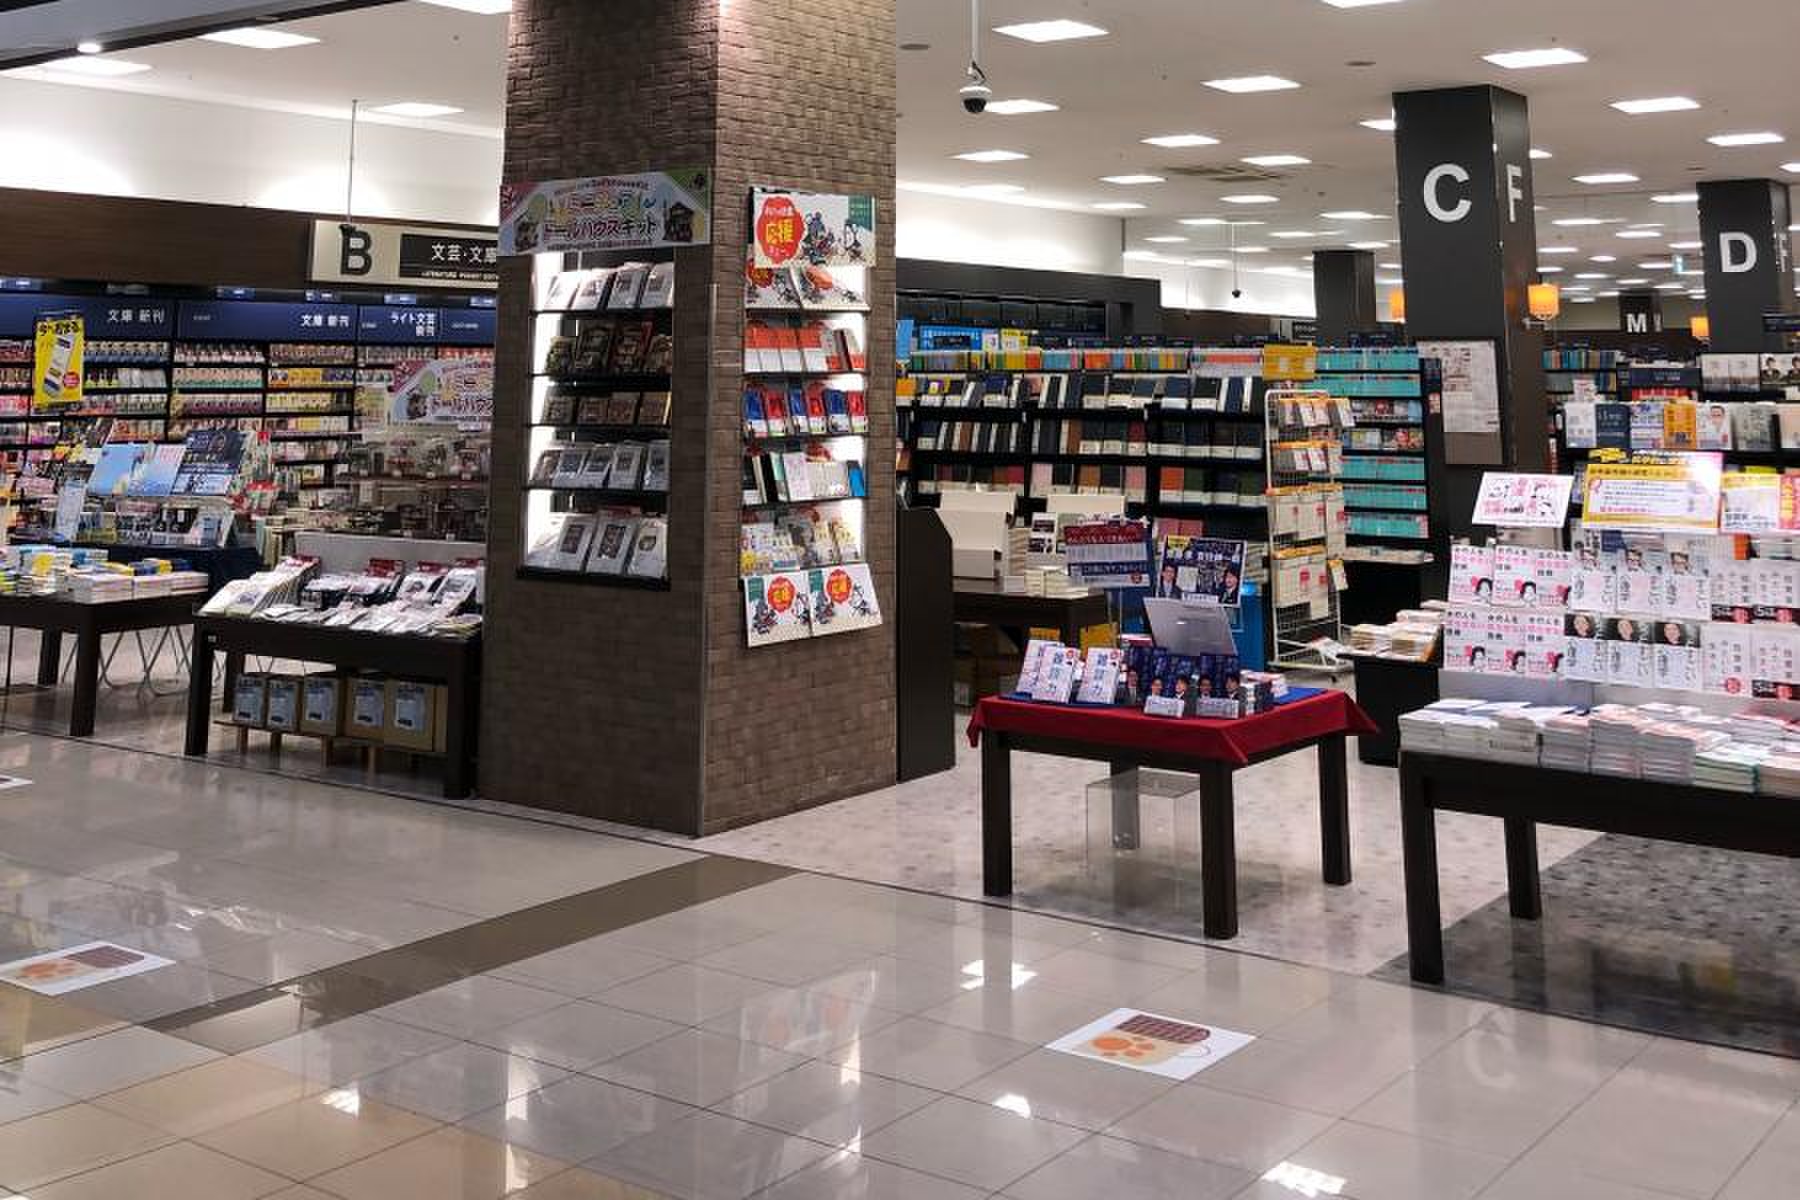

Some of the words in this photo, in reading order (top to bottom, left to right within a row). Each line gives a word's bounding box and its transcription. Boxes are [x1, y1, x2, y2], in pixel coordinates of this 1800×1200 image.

[1424, 163, 1472, 222] C
[1506, 163, 1522, 222] F
[340, 225, 373, 276] B
[1719, 231, 1757, 273] D
[1626, 312, 1647, 333] M
